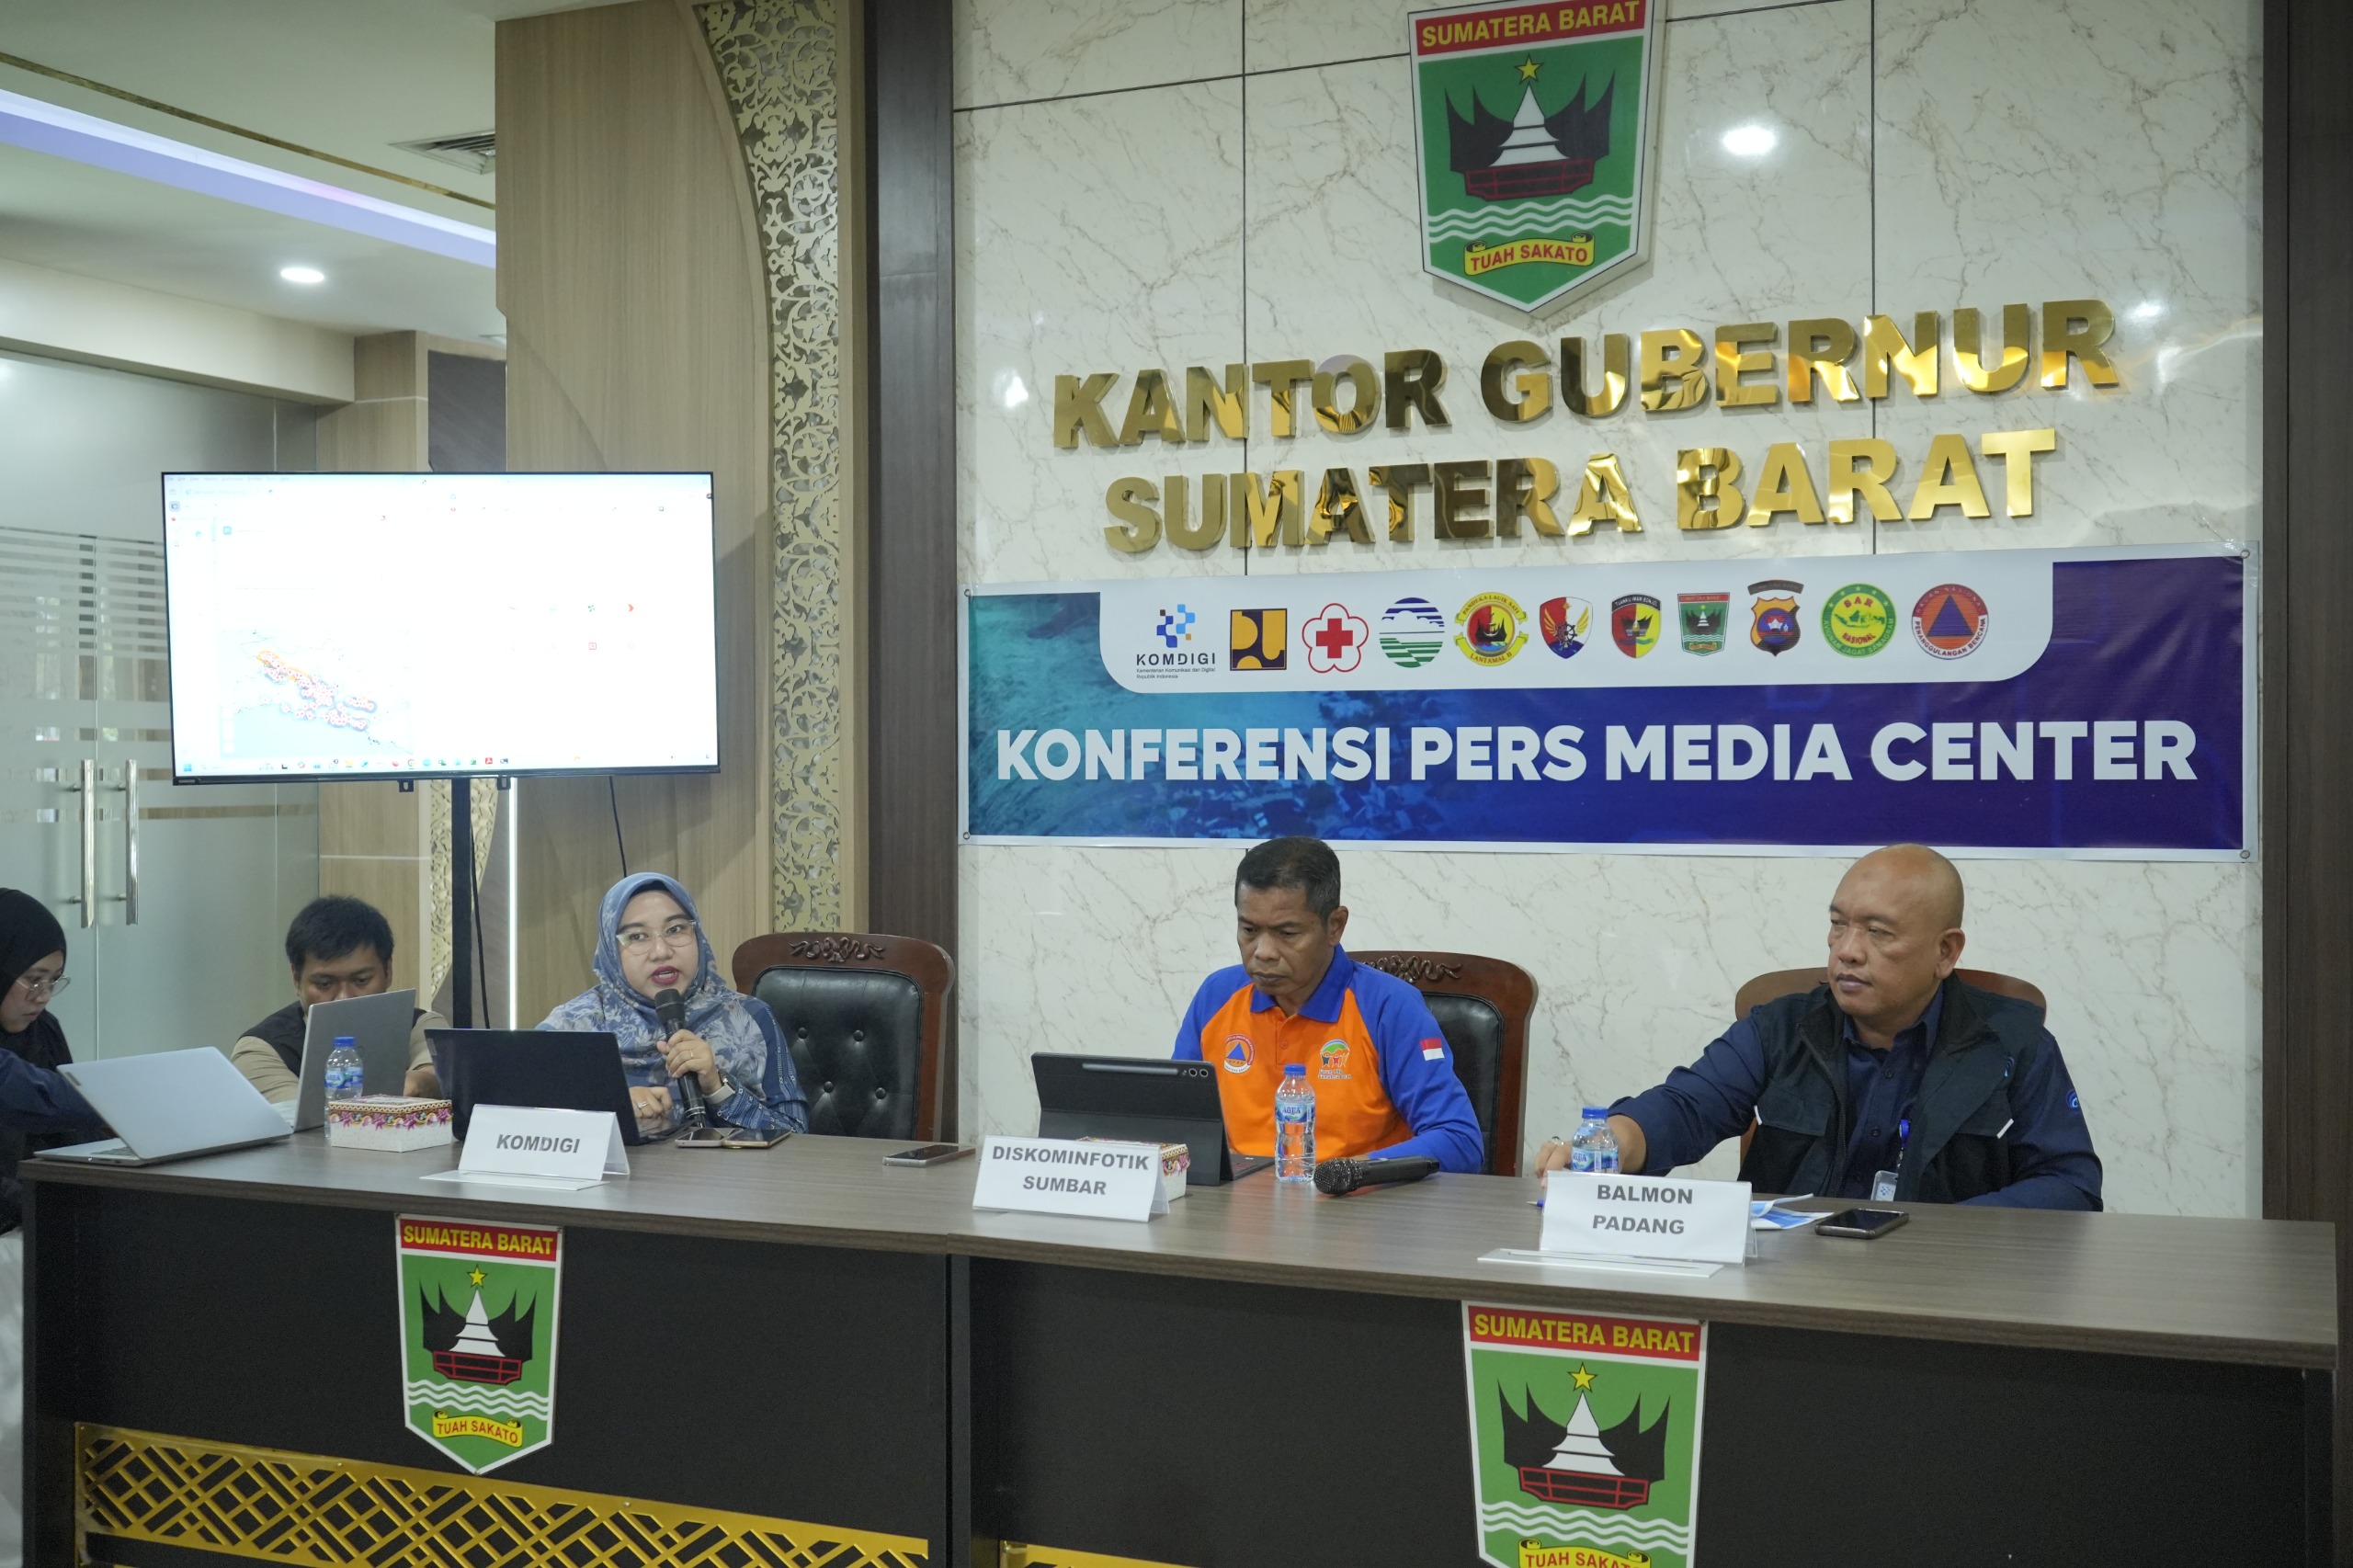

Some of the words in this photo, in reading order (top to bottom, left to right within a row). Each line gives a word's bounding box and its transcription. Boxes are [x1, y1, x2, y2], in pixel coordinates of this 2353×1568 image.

[1422, 12, 1552, 47] SUMATERA
[1559, 1, 1640, 30] BARAT
[1471, 247, 1515, 271] TUAH
[1520, 244, 1587, 263] SAKATO
[1054, 349, 1452, 449] KANTOR
[1481, 300, 2120, 423] GUBERNUR
[1105, 454, 1644, 552] SUMATERA
[1677, 428, 2056, 530] BARAT
[1843, 596, 1873, 608] SAR
[1842, 632, 1876, 644] NASIONAL
[1915, 620, 1967, 656] PENANGGULANGAN
[1968, 618, 1986, 648] BENCANA
[1136, 653, 1215, 665] KOMDIGI
[1470, 652, 1506, 663] LANTAMAL
[997, 726, 1390, 781] KONFERENSI
[1411, 724, 1587, 781] PERS
[1606, 723, 1853, 781] MEDIA
[1870, 720, 2198, 781] CENTER
[1282, 1107, 1301, 1115] AQUA
[495, 1133, 581, 1154] KOMDIGI
[992, 1145, 1149, 1171] DISKOMINFOTIK
[1022, 1176, 1108, 1196] SUMBAR
[1597, 1184, 1693, 1205] BALMON
[1592, 1214, 1686, 1235] PADANG
[404, 1225, 494, 1249] SUMATERA
[497, 1233, 554, 1255] BARAT
[1474, 1313, 1606, 1346] SUMATERA
[1613, 1325, 1695, 1354] BARAT
[437, 1420, 468, 1436] TUAH
[471, 1420, 519, 1444] SAKATO
[1525, 1551, 1570, 1568] TUAH
[1575, 1551, 1637, 1568] SAKA
